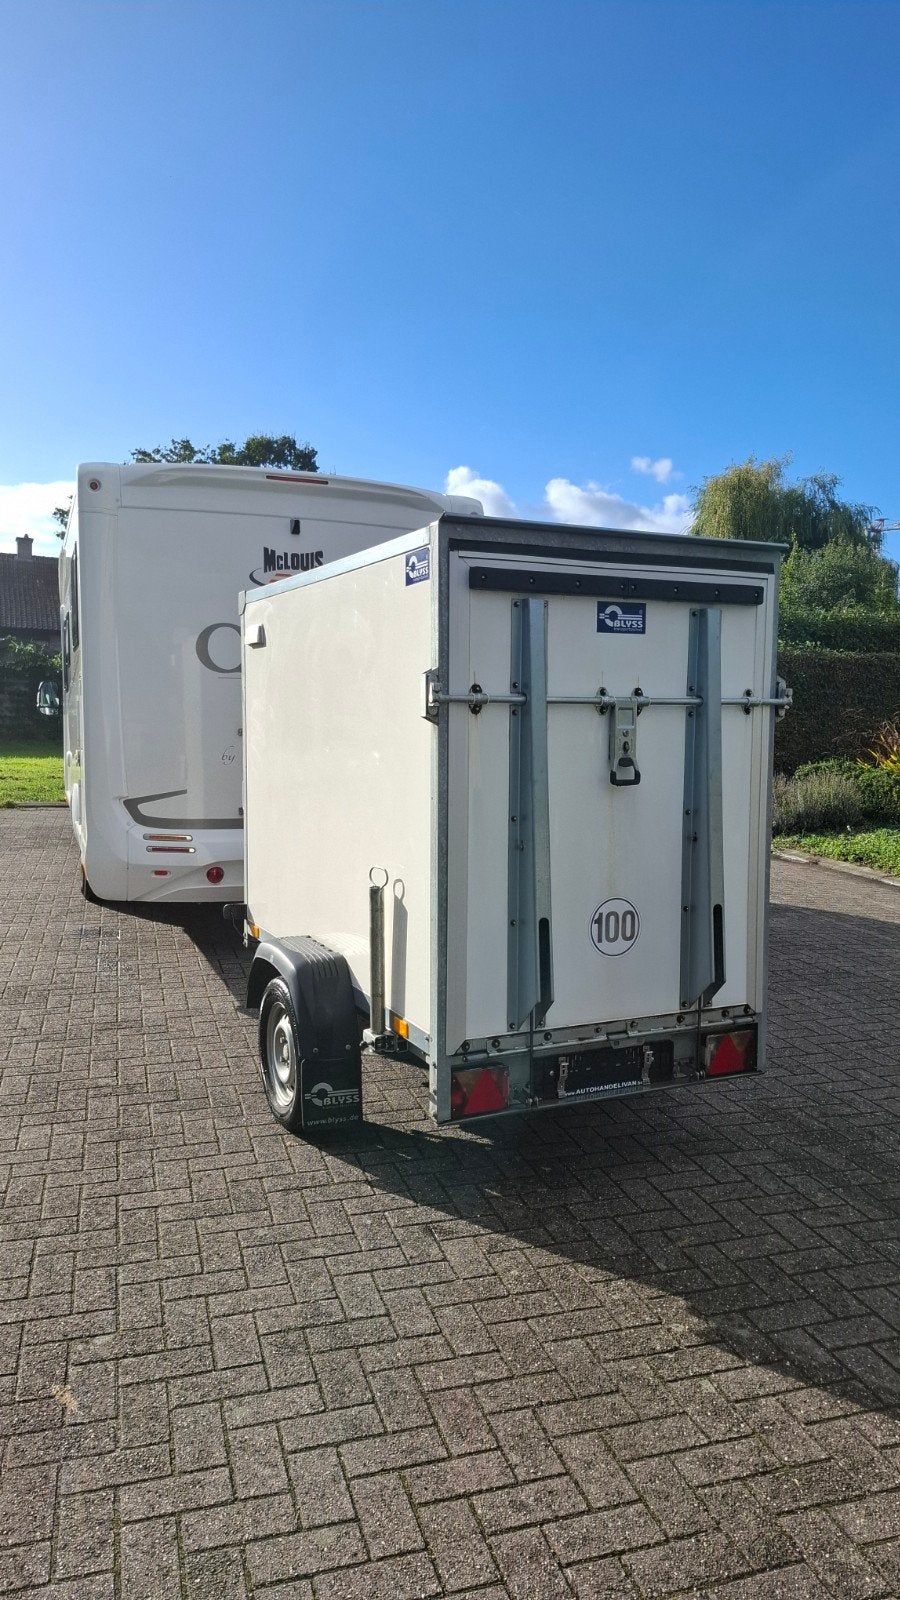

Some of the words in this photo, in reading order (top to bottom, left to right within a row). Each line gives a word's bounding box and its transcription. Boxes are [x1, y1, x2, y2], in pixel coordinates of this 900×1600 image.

[613, 620, 643, 628] BLYSS
[593, 910, 636, 944] 100
[323, 1094, 360, 1106] BLYSS
